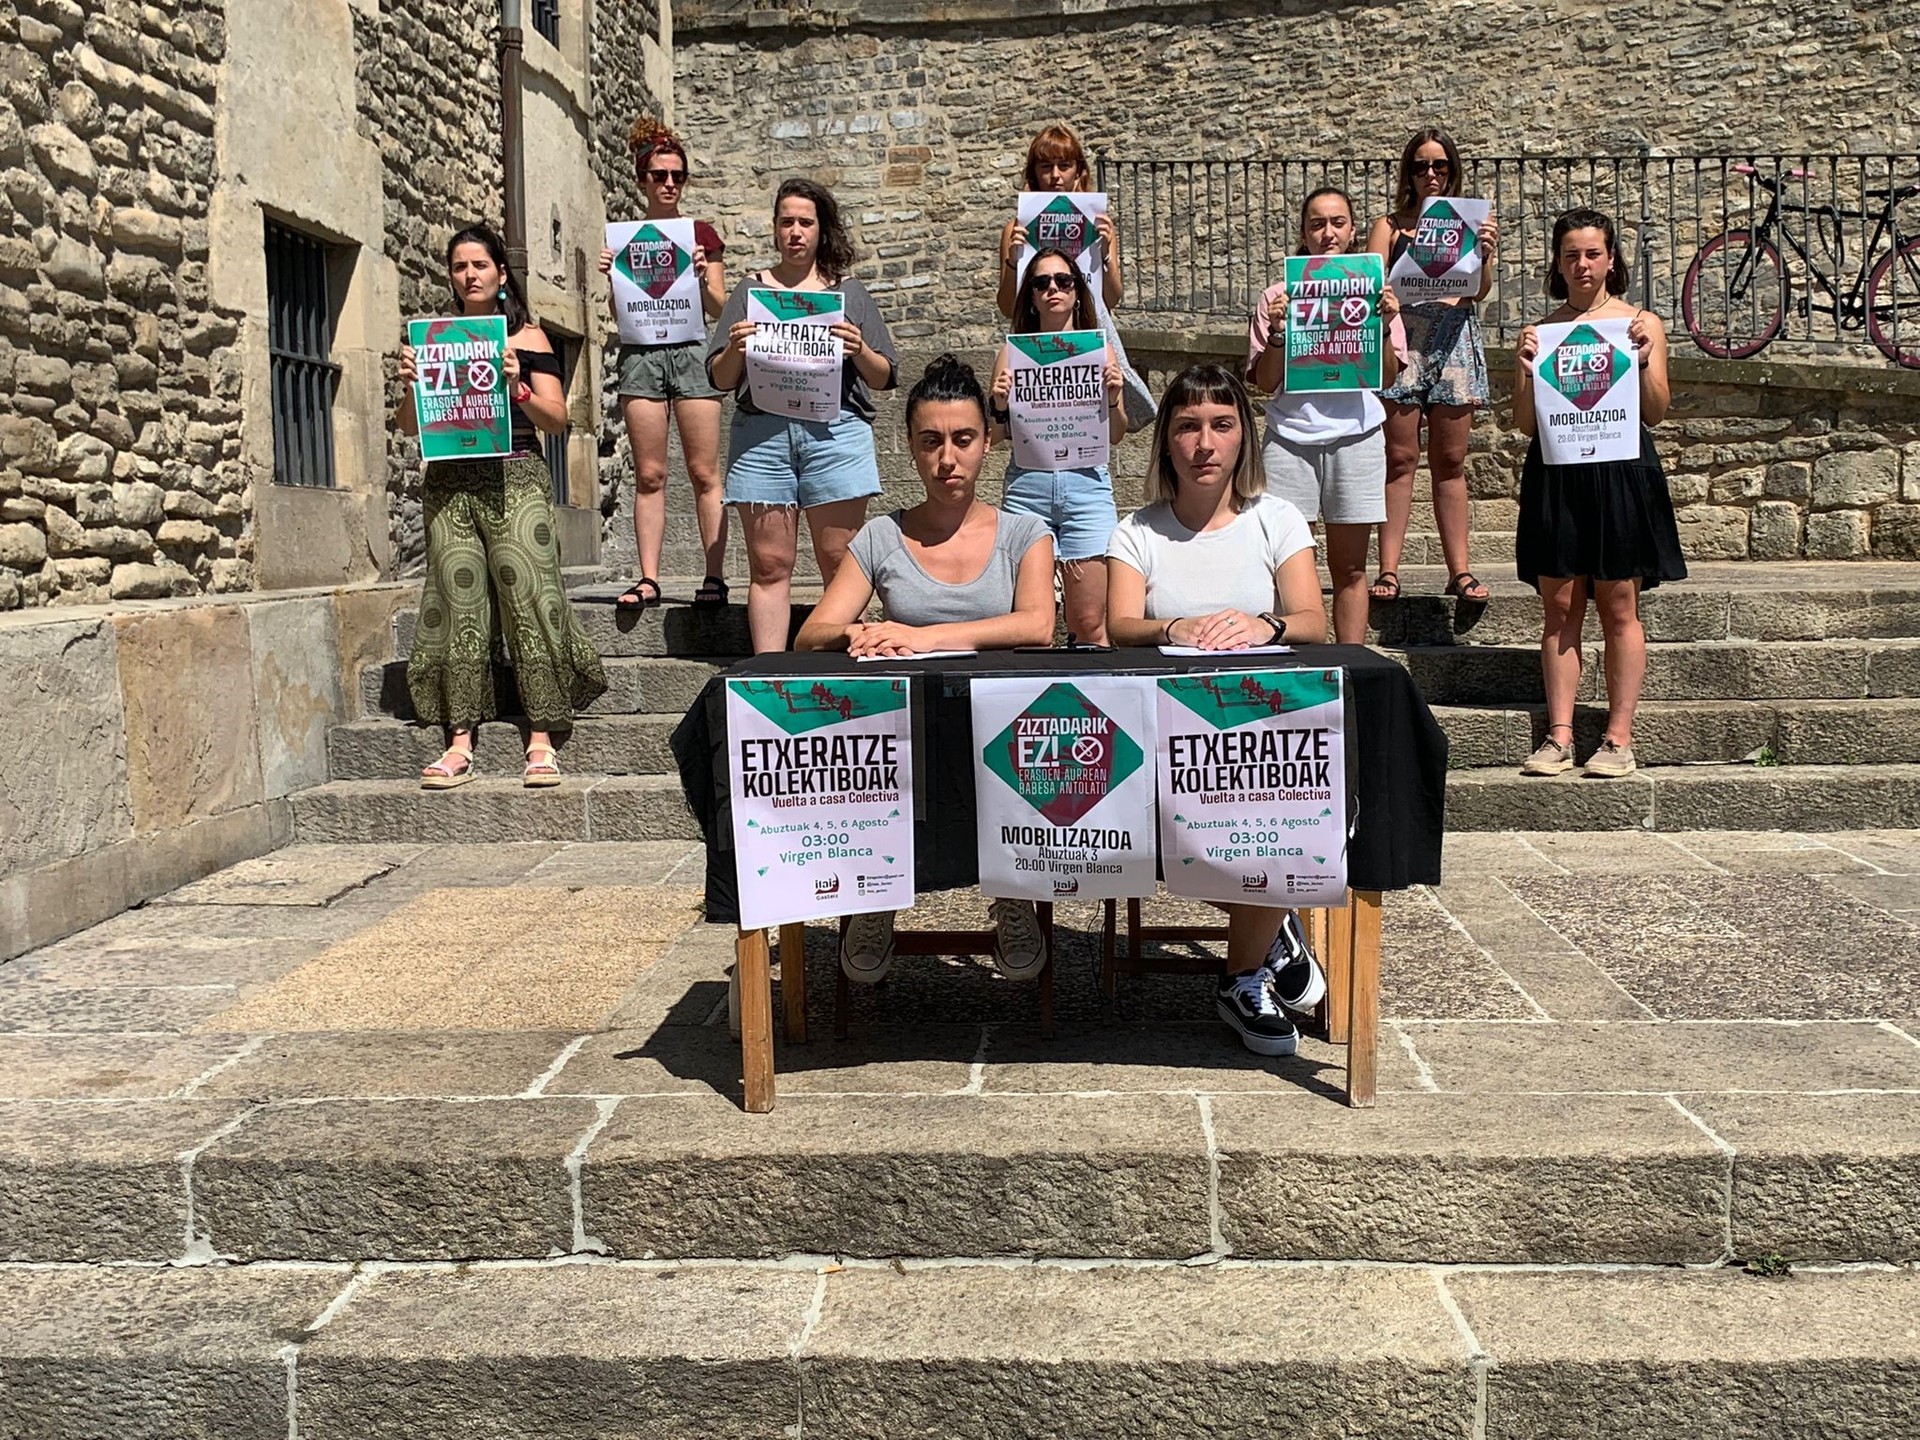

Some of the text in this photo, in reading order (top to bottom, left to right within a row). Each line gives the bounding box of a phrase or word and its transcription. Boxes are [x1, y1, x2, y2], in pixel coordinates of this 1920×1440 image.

[1040, 213, 1083, 223] ZIZTADARIK
[1040, 224, 1059, 240] EZ!
[1415, 228, 1436, 246] EZ!
[629, 240, 673, 252] ZIZTADARIK
[630, 252, 652, 269] EZ!
[1291, 277, 1375, 298] ZIZTADARIK
[1400, 277, 1468, 287] MOBILIZAZIOA
[627, 299, 690, 312] MOBILIZAZIOA
[1291, 298, 1329, 331] EZ!
[755, 322, 835, 342] ETXERATZE
[1292, 329, 1375, 344] ERASOEN AURREAN
[413, 341, 500, 363] ZIZTADARIK
[753, 340, 835, 357] KOLEKTIBOAK
[1292, 342, 1375, 357] BABESA ANTOLATU
[1558, 343, 1610, 357] ZIZTADARIK
[1558, 356, 1583, 376] EZ!
[417, 362, 459, 397] EZ!
[782, 377, 807, 385] 03:00
[1014, 365, 1100, 387] ETXERATZE
[771, 383, 793, 391] Virgen
[1015, 384, 1101, 402] KOLEKTIBOAK
[422, 394, 504, 410] ERASOEN AURREAN
[1031, 401, 1050, 409] Vuelta
[1073, 399, 1101, 407] Colectiva
[423, 406, 504, 422] BABESA ANTOLATU
[1550, 409, 1626, 426] MOBILIZAZIOA
[1047, 423, 1074, 432] 03:00
[1035, 433, 1059, 442] Virgen
[1558, 431, 1621, 443] 20:00 Virgen Blanca
[1018, 717, 1108, 736] ZIZTADARIK
[741, 735, 897, 772] ETXERATZE
[1019, 735, 1059, 768] EZ!
[1169, 728, 1329, 767] ETXERATZE
[743, 766, 899, 798] KOLEKTIBOAK
[1019, 768, 1106, 781] ERASOEN AURREAN
[1171, 762, 1330, 794] KOLEKTIBOAK
[1019, 781, 1106, 795] BABESA ANTOLATU
[772, 792, 899, 808] Vuelta a casa Colectiva
[1200, 789, 1331, 804] Vuelta a casa Colectiva
[761, 818, 889, 835] Abuztuak 4, 5, 6 Agosto
[1187, 817, 1320, 830] Abuztuak 4, 5, 6 Agosto
[802, 833, 849, 847] 03:00
[1001, 826, 1132, 850] MOBILIZAZIOA
[1230, 831, 1279, 844] 03:00
[780, 847, 873, 866] Virgen Blanca
[1039, 847, 1098, 861] Abuztuak 3
[1206, 846, 1303, 862] Virgen Blanca
[1015, 858, 1122, 875] 20:00 Virgen Blanca
